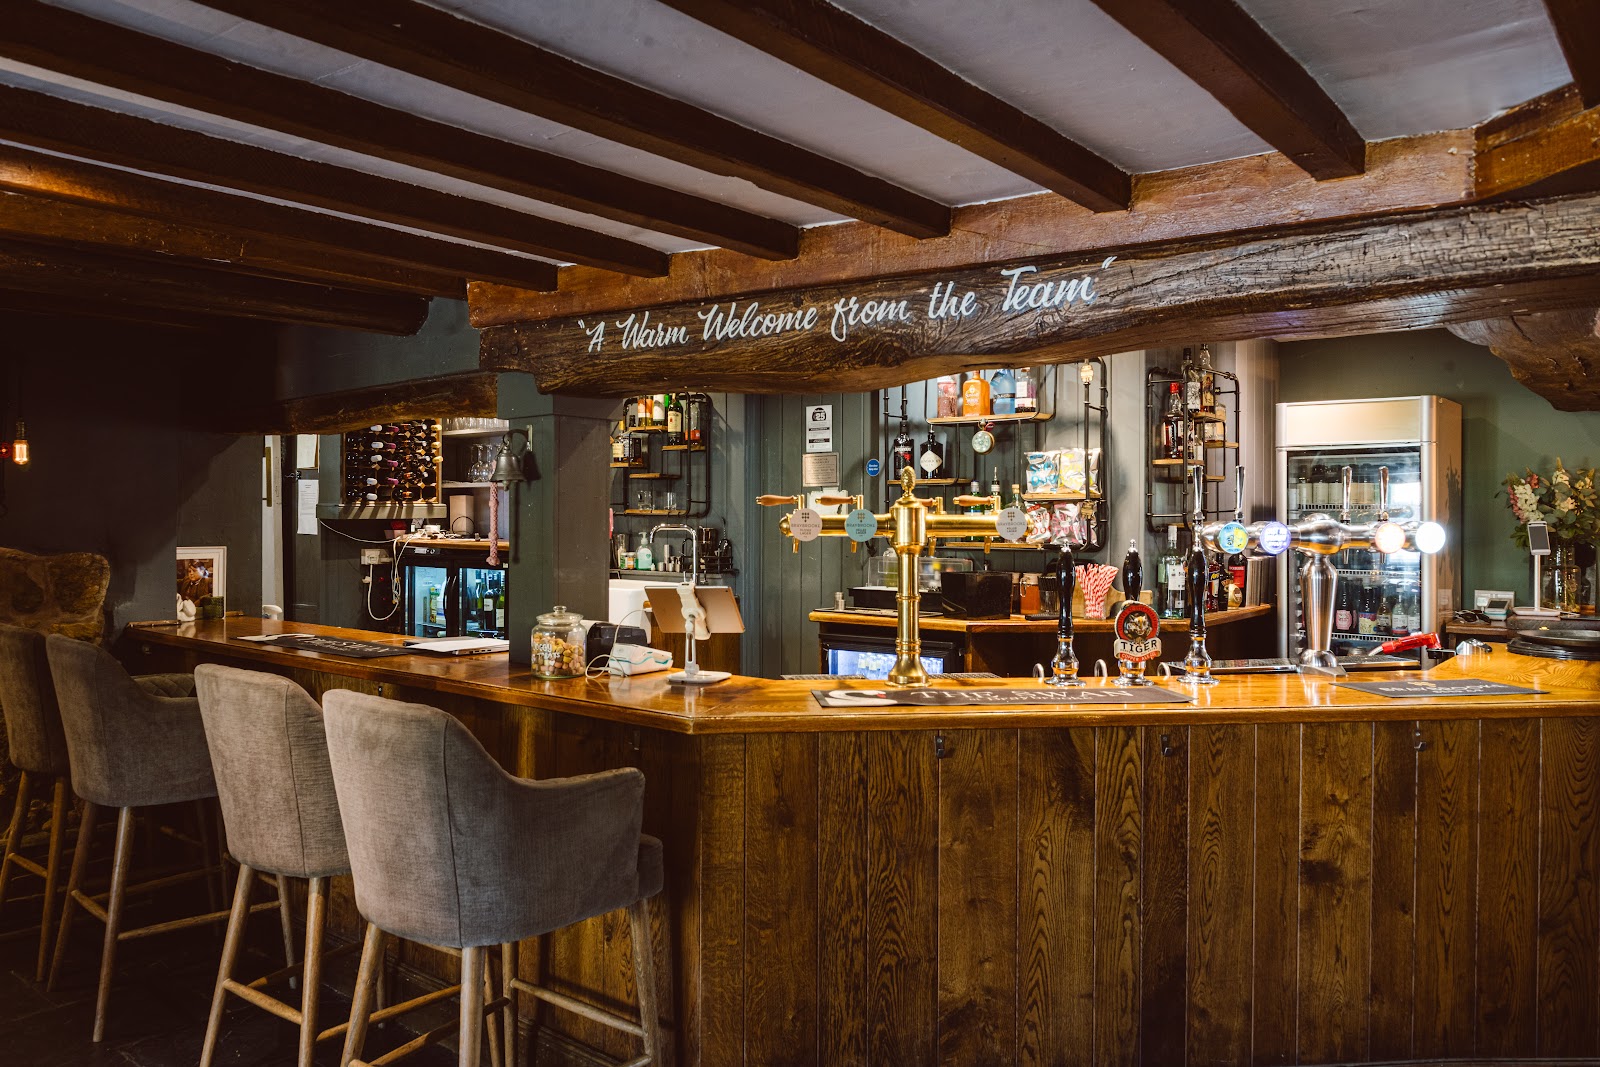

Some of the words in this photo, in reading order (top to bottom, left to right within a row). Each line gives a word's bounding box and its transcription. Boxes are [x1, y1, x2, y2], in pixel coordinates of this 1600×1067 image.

[616, 311, 690, 350] Warm
[697, 302, 818, 342] Welcome
[831, 296, 911, 343] from
[928, 280, 977, 319] the
[1120, 639, 1157, 653] TIGER
[1121, 653, 1140, 662] COPPER
